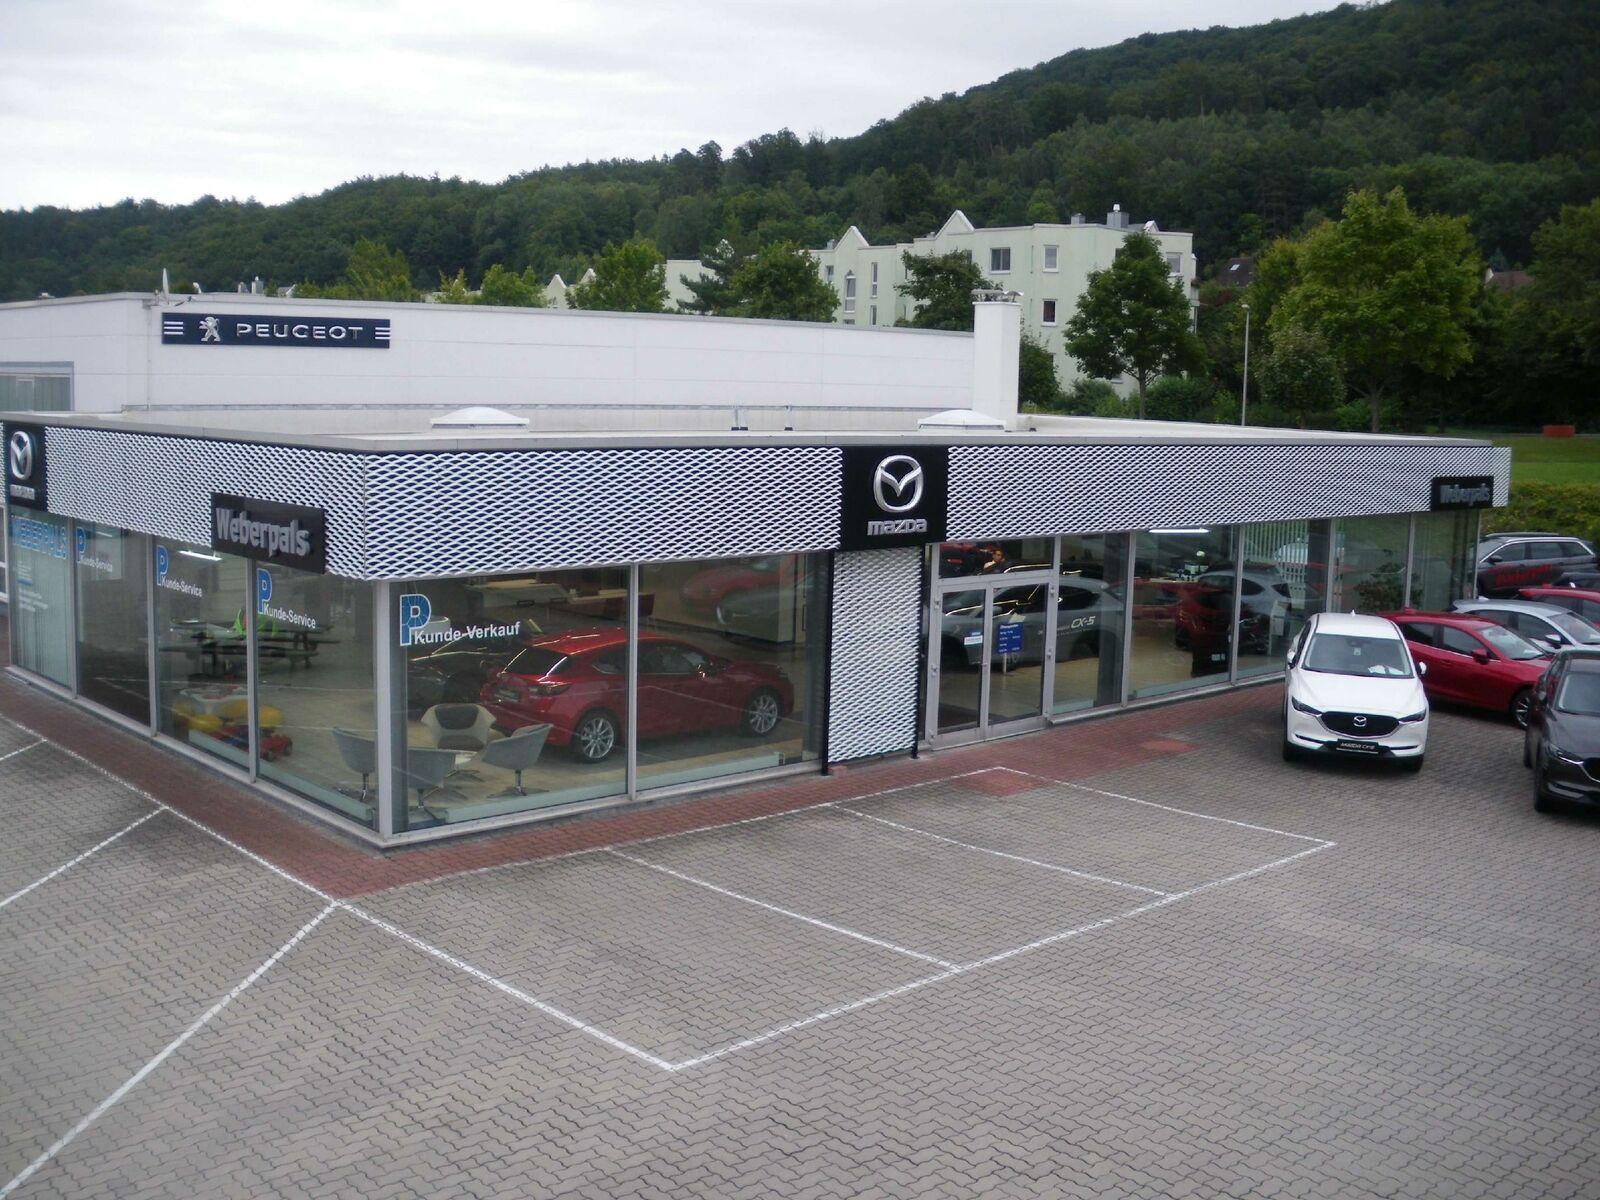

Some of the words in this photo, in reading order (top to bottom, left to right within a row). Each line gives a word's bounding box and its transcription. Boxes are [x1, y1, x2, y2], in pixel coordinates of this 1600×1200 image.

[236, 322, 364, 340] PEUGEOT
[215, 507, 311, 557] Weberpals
[867, 518, 928, 536] mazda
[161, 575, 203, 598] Kunde-Service
[263, 602, 317, 630] Kunde-Service
[400, 593, 432, 646] P
[414, 621, 521, 645] Kunde-Verkauf
